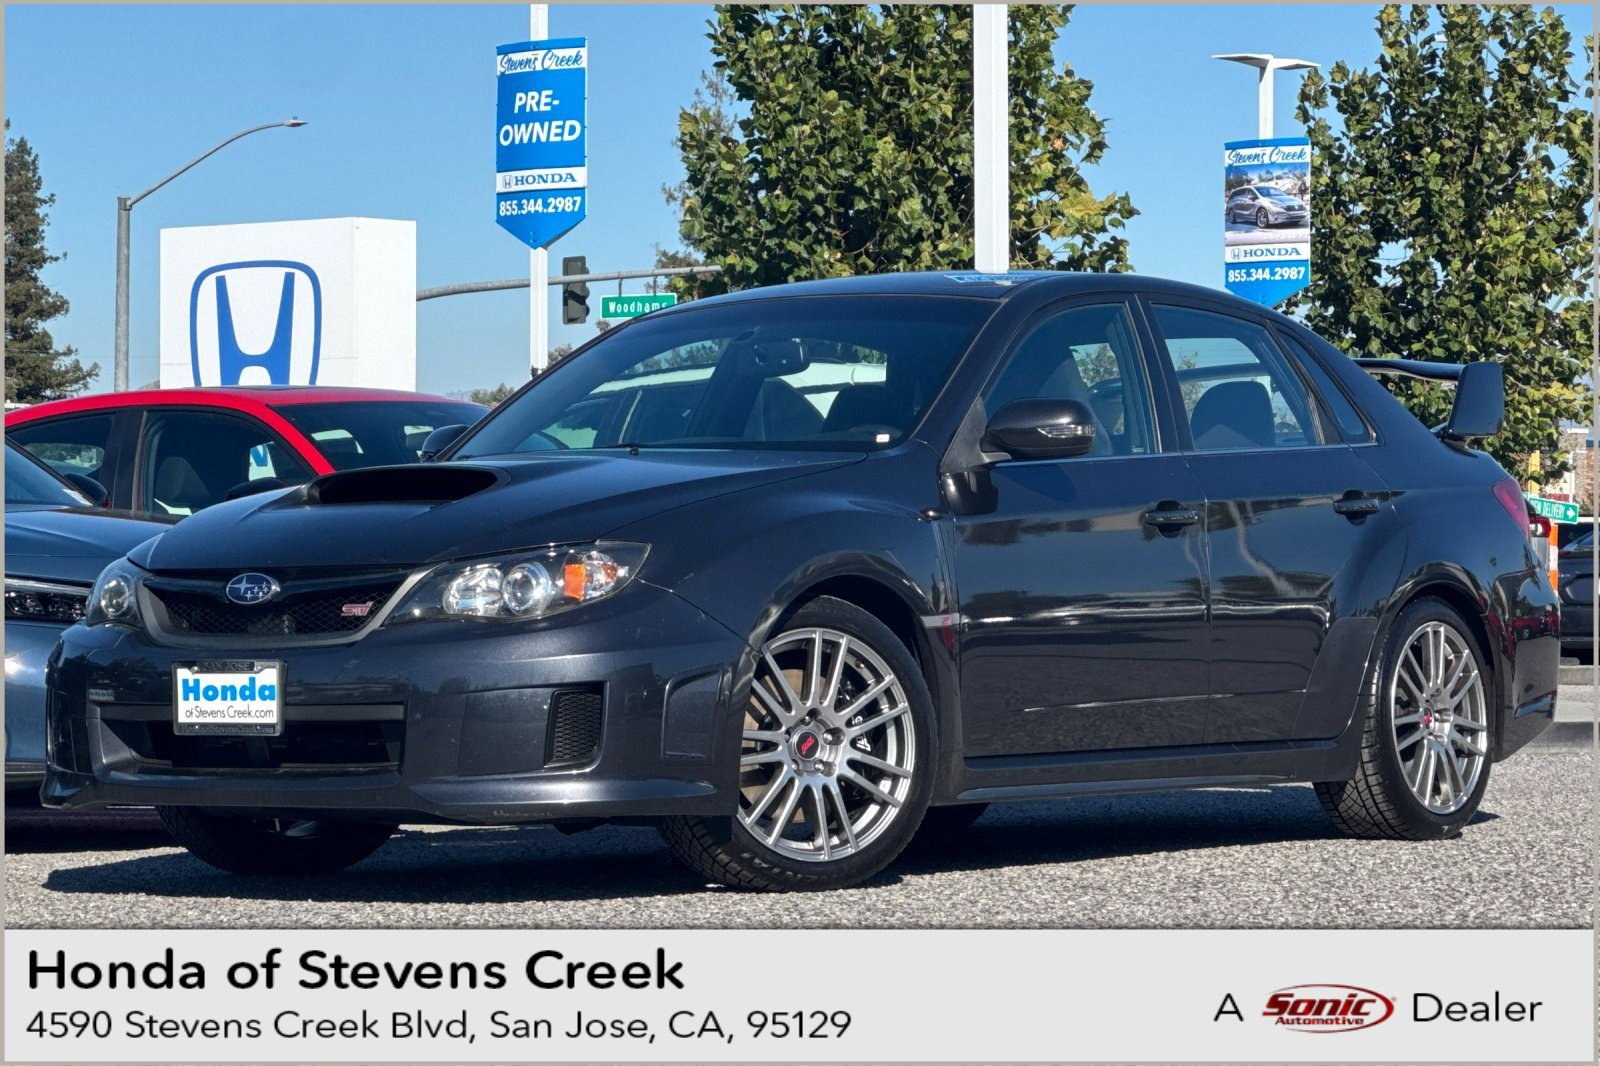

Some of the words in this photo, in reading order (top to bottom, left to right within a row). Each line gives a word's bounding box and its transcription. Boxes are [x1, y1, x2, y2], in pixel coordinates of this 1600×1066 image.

[541, 49, 583, 70] Creek
[514, 89, 560, 114] PRE-
[499, 120, 581, 147] OWNED
[1269, 146, 1307, 164] Creek
[514, 173, 577, 186] HONDA
[499, 196, 581, 217] 855.344.2987
[1243, 247, 1301, 258] HONDA
[1228, 266, 1306, 283] 855.344.2987
[1543, 501, 1566, 519] DELIVERY
[182, 676, 276, 702] Honda
